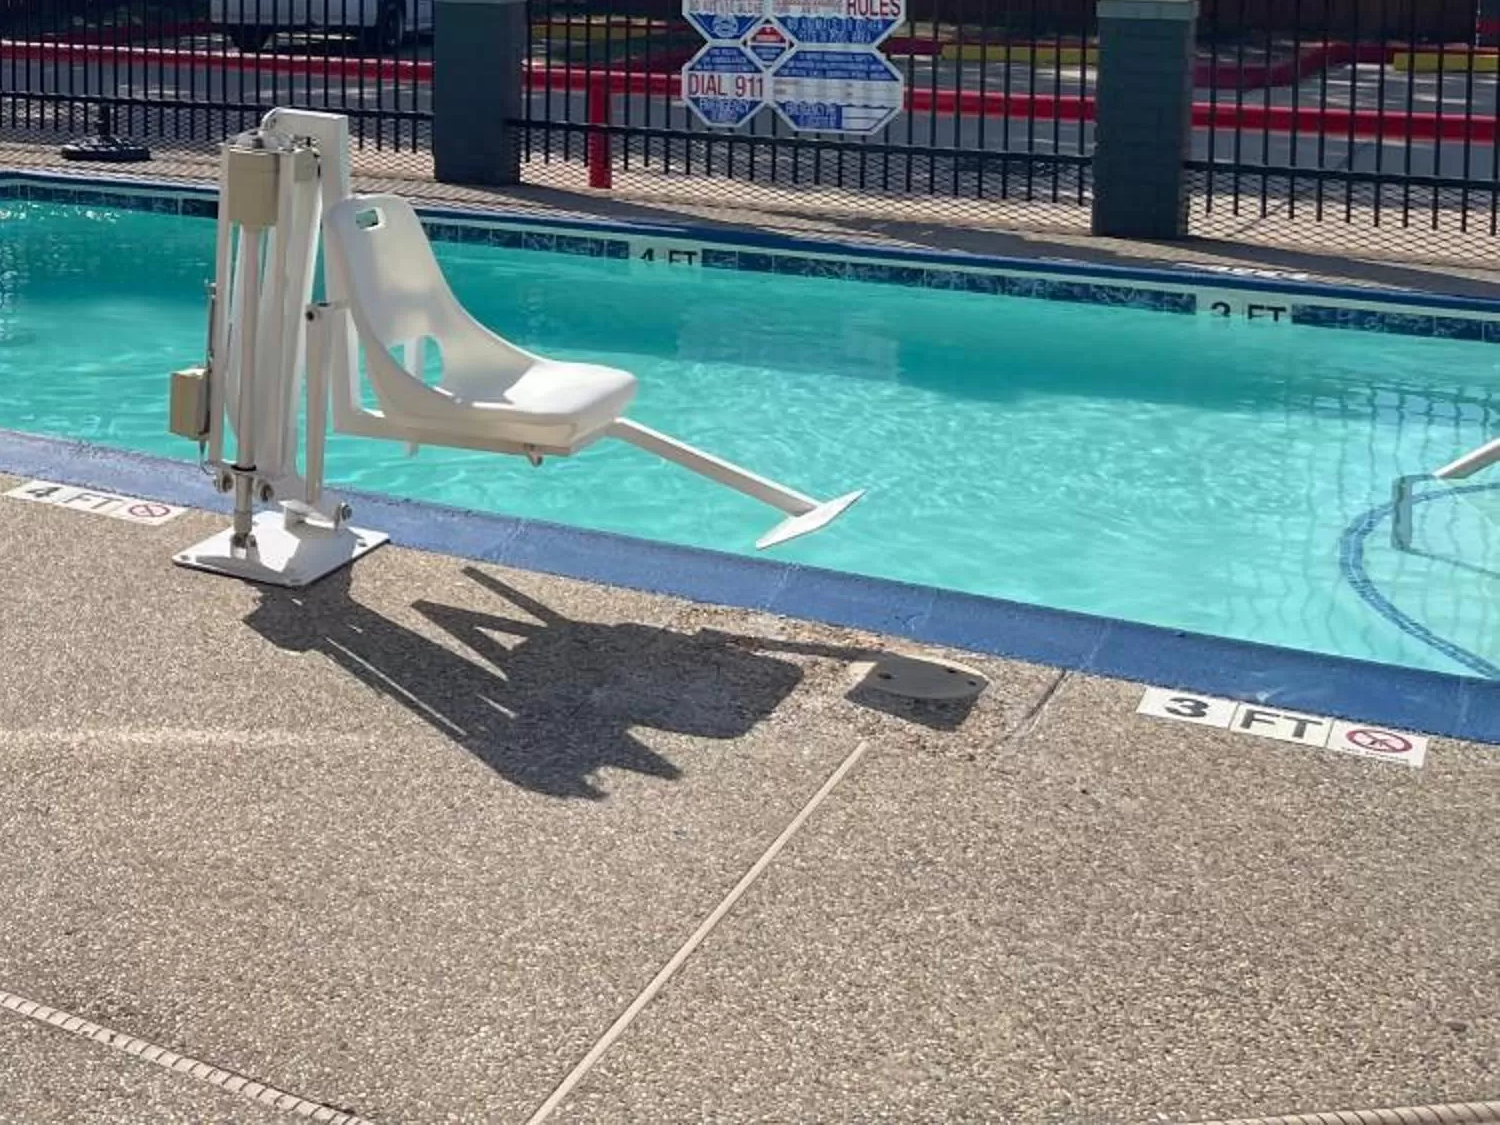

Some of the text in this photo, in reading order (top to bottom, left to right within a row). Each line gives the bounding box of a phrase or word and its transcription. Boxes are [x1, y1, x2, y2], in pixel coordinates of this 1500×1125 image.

[687, 73, 728, 96] DIAL
[735, 75, 763, 98] 911
[61, 492, 125, 510] FT
[1164, 696, 1325, 739] 3 FT
